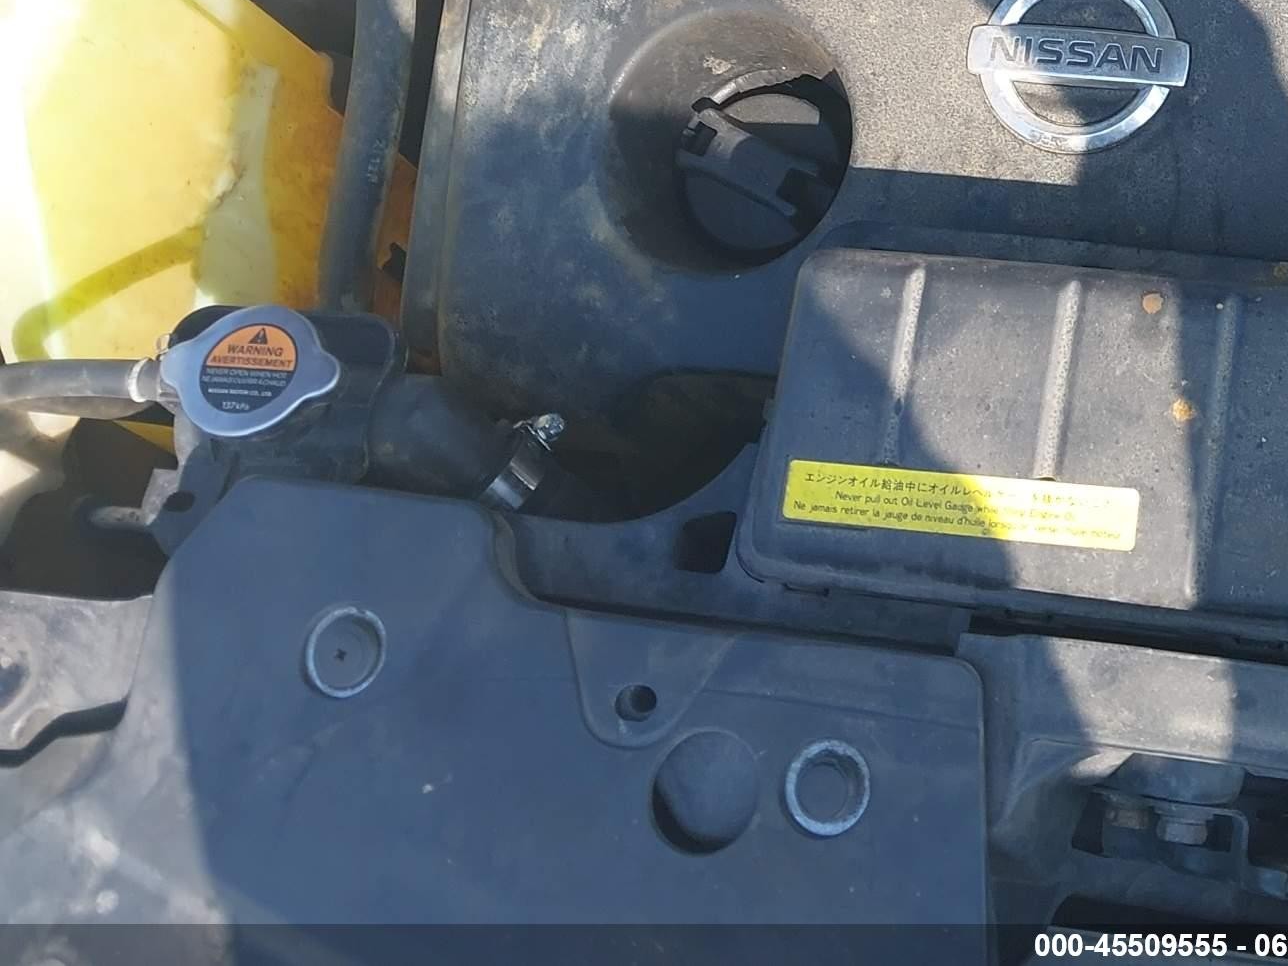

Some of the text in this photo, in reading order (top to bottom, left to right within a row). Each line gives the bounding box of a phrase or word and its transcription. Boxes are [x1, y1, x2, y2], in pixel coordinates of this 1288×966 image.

[989, 34, 1164, 74] NISSAN
[226, 343, 284, 357] WARNING
[210, 355, 294, 368] AVERTISSEMENT
[834, 490, 863, 502] Never
[865, 493, 881, 505] pull
[883, 497, 898, 506] out
[901, 496, 913, 506] Oil
[915, 498, 942, 510] Level
[793, 500, 806, 511] Ne
[809, 502, 838, 514] jamais
[840, 504, 870, 516] retirer
[872, 508, 881, 518] la
[882, 510, 909, 523] jauge
[911, 512, 923, 522] de
[924, 514, 955, 525] niveau
[956, 515, 986, 528] d'huile
